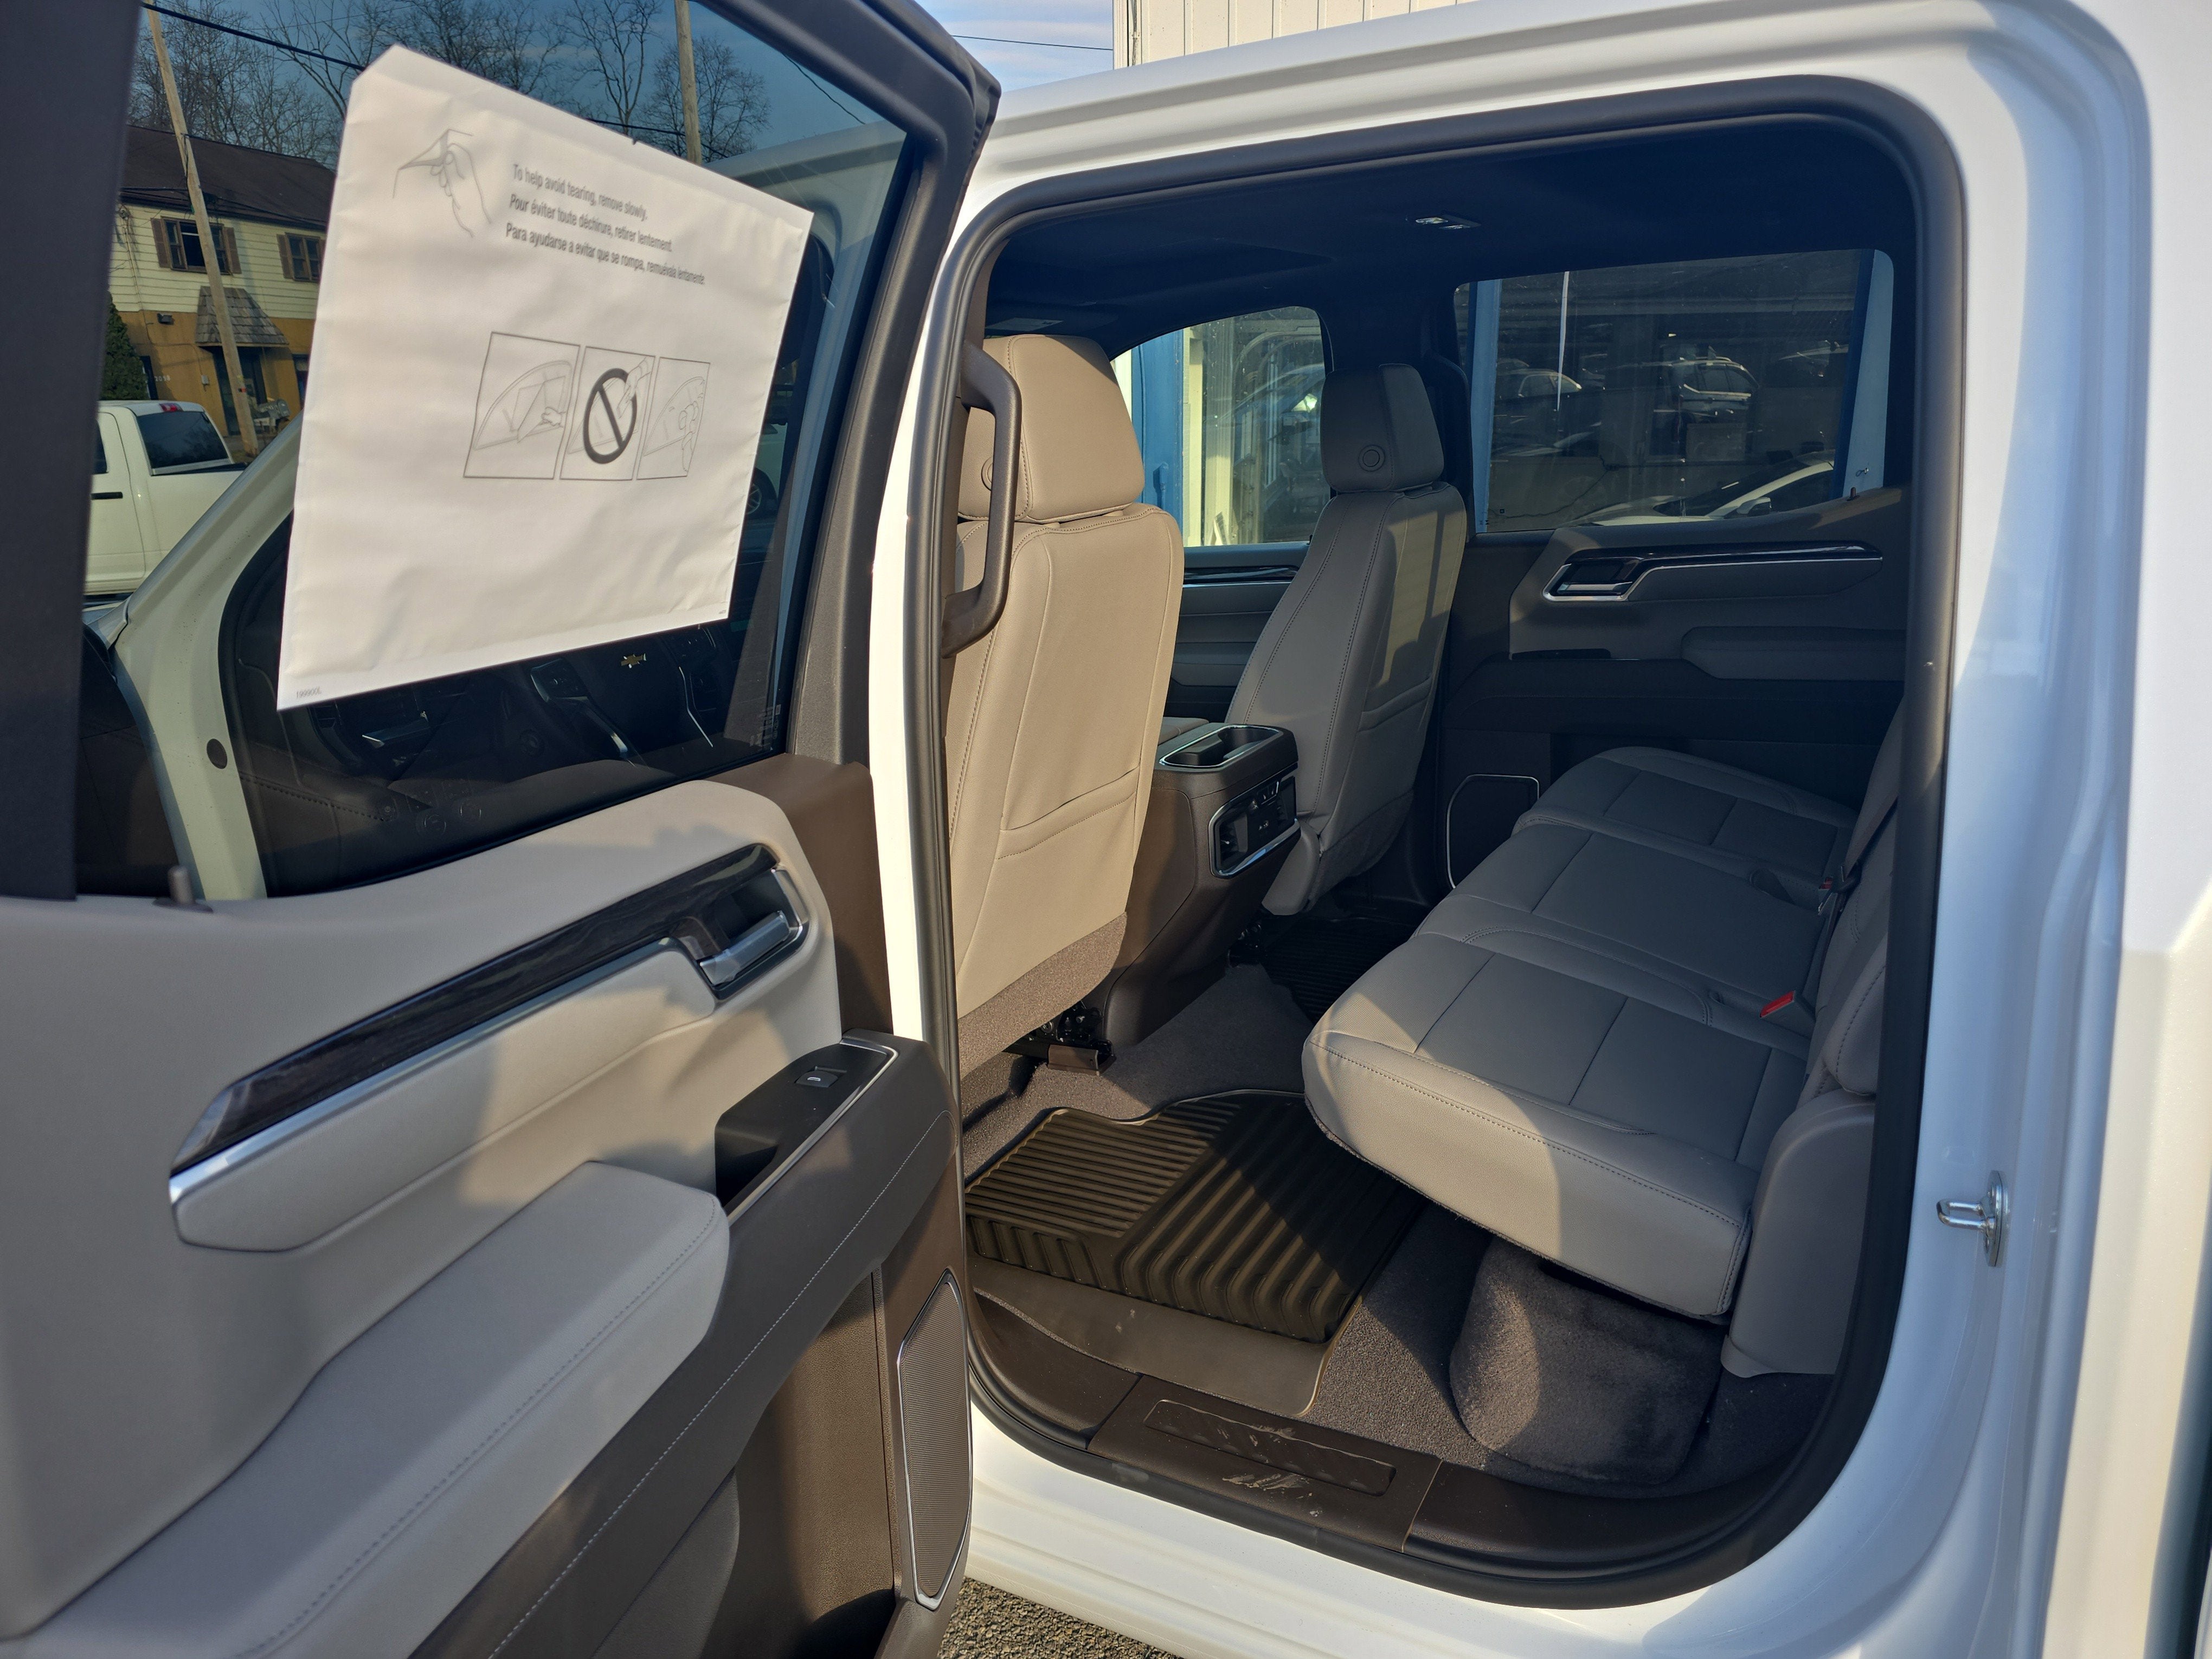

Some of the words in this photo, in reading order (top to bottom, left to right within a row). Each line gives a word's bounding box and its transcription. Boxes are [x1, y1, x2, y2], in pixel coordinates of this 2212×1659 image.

[513, 164, 522, 181] To
[525, 167, 542, 189] help
[545, 177, 565, 194] avoid
[567, 181, 596, 207] tearing,
[599, 194, 623, 212] remove
[510, 194, 529, 212] Pour
[531, 199, 556, 219] éviter
[557, 207, 577, 226] toute
[615, 226, 636, 242] retirer
[506, 223, 526, 241] Para
[529, 232, 567, 251] ayudarse
[569, 242, 574, 253] a
[575, 242, 596, 258] evitar
[597, 249, 609, 262] que
[610, 252, 620, 264] se
[621, 255, 645, 273] rompa,
